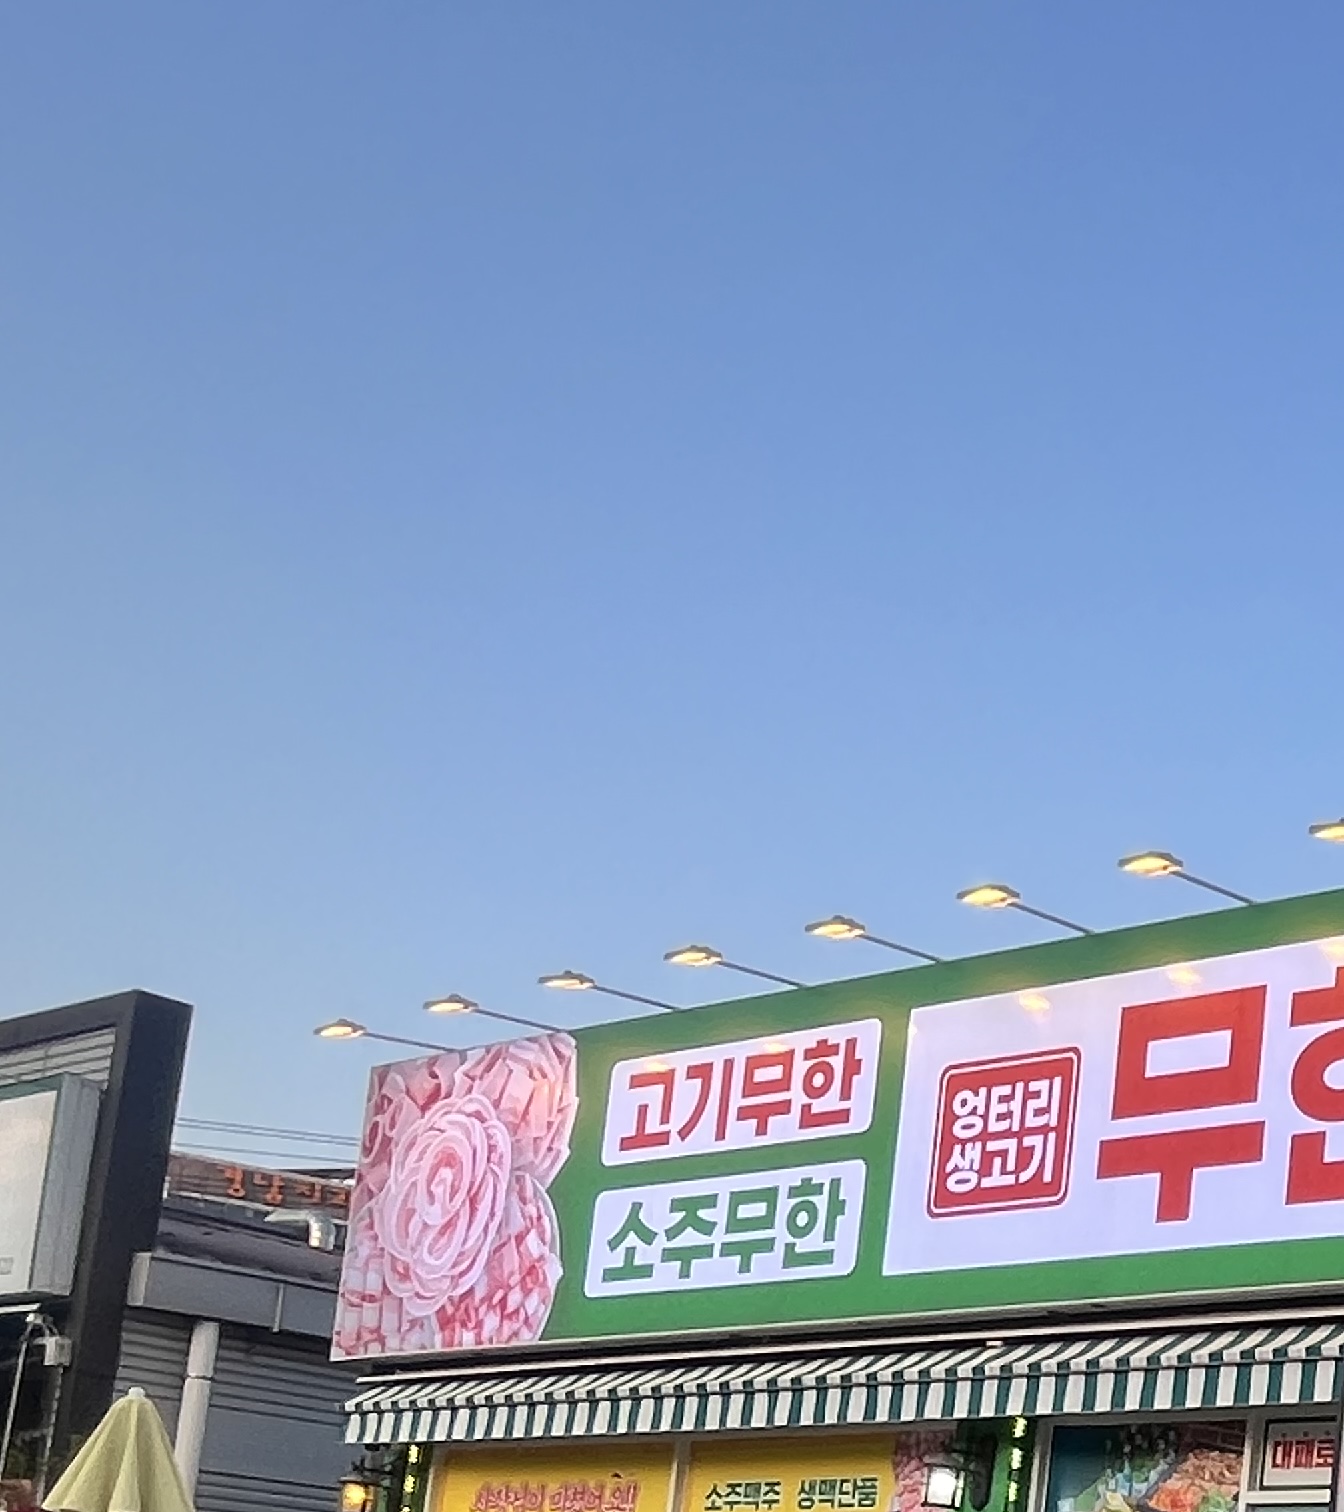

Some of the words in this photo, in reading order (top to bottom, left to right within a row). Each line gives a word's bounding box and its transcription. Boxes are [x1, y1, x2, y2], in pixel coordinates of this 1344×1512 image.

[619, 1039, 863, 1152] 고기무한
[951, 1076, 1061, 1139] 엉터리
[945, 1131, 1055, 1193] 생고기
[602, 1177, 847, 1283] 소주무한
[704, 1481, 782, 1511] 소주맥주
